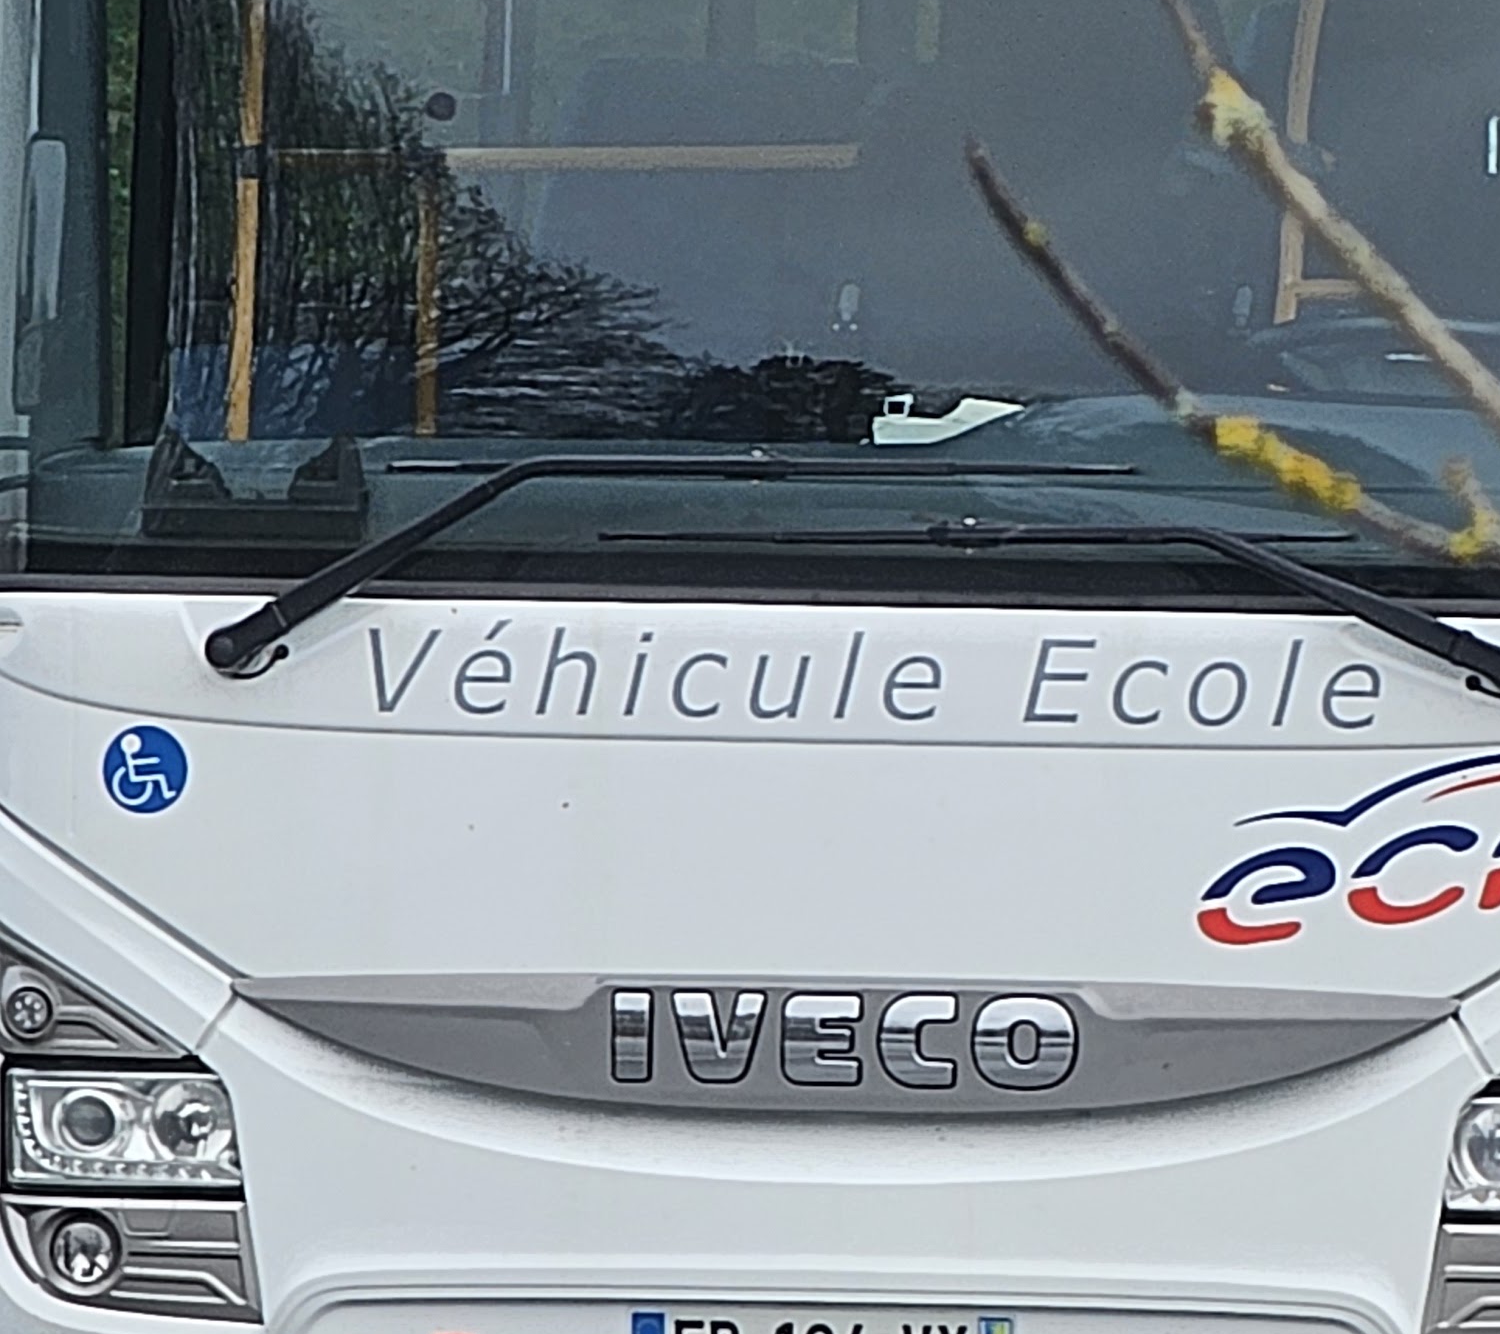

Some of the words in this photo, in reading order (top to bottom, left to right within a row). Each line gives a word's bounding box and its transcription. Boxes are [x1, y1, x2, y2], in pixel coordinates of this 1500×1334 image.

[368, 618, 943, 721] Véhicule
[1022, 637, 1382, 730] Ecole
[610, 986, 1080, 1092] IVECO
